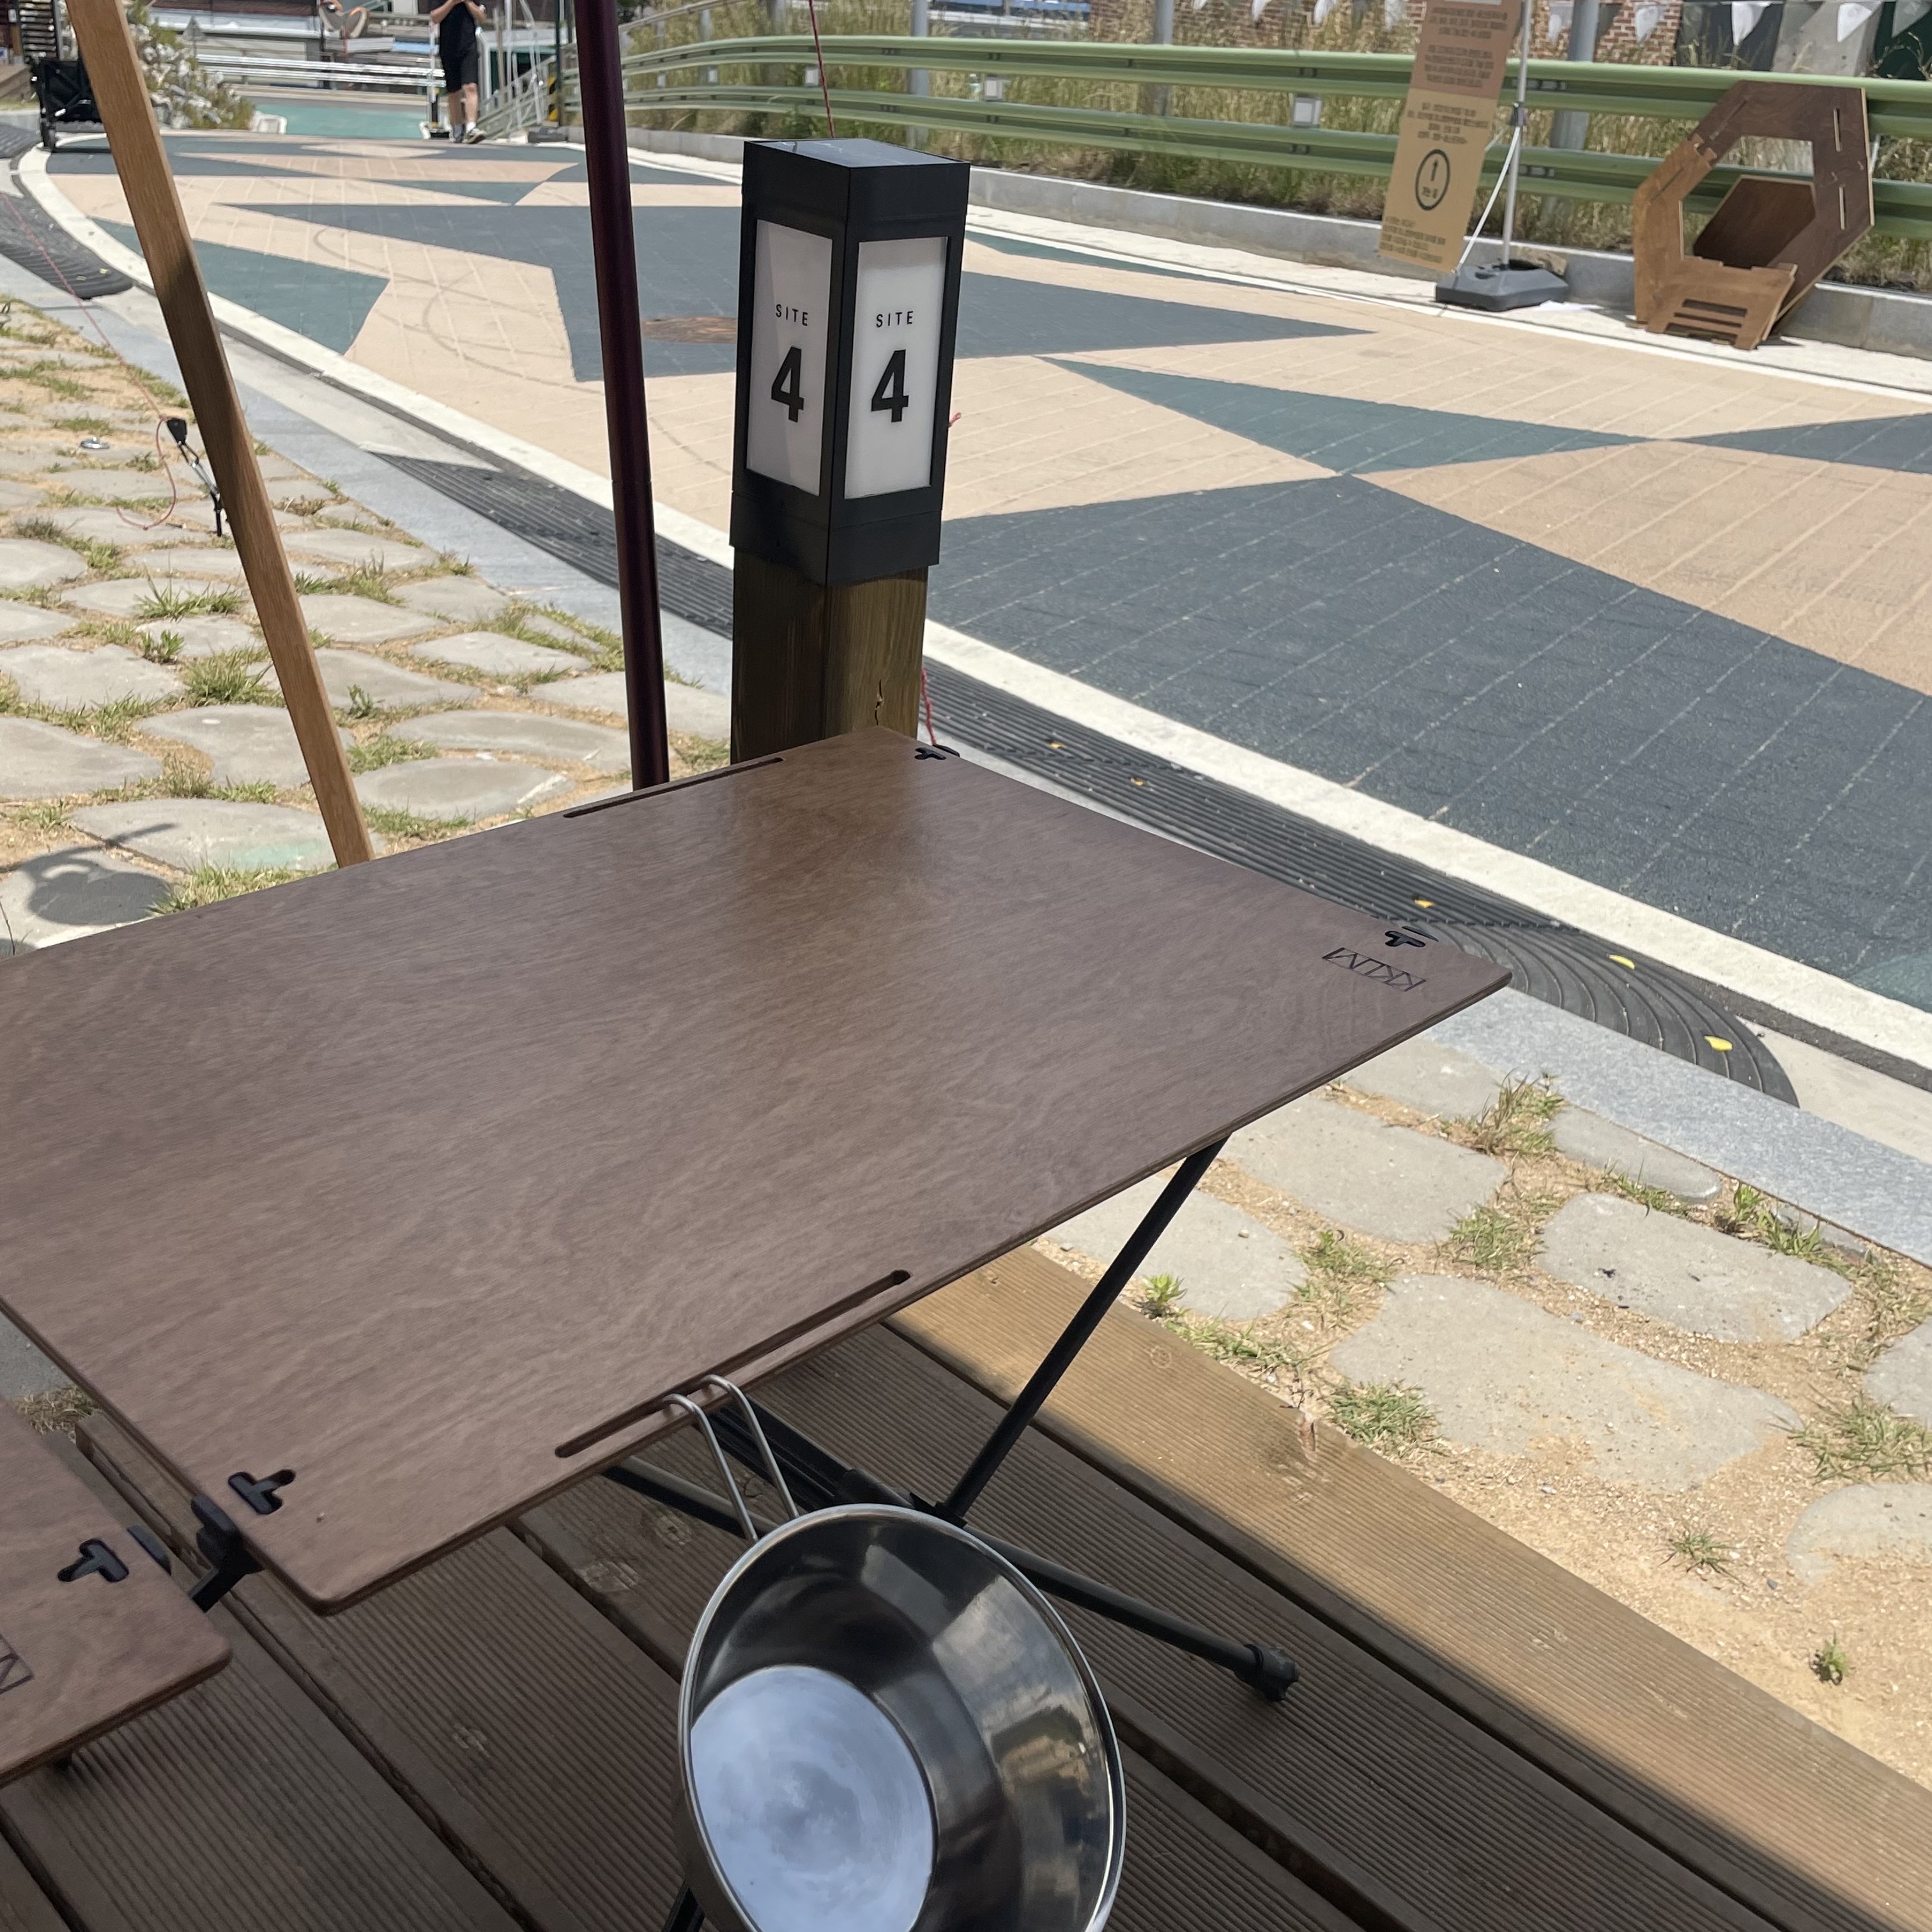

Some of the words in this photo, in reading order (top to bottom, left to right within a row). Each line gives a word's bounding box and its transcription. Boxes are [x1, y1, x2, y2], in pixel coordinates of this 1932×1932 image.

[775, 303, 808, 326] SITE
[875, 310, 914, 328] SITE
[770, 346, 804, 423] 4
[871, 349, 909, 423] 4
